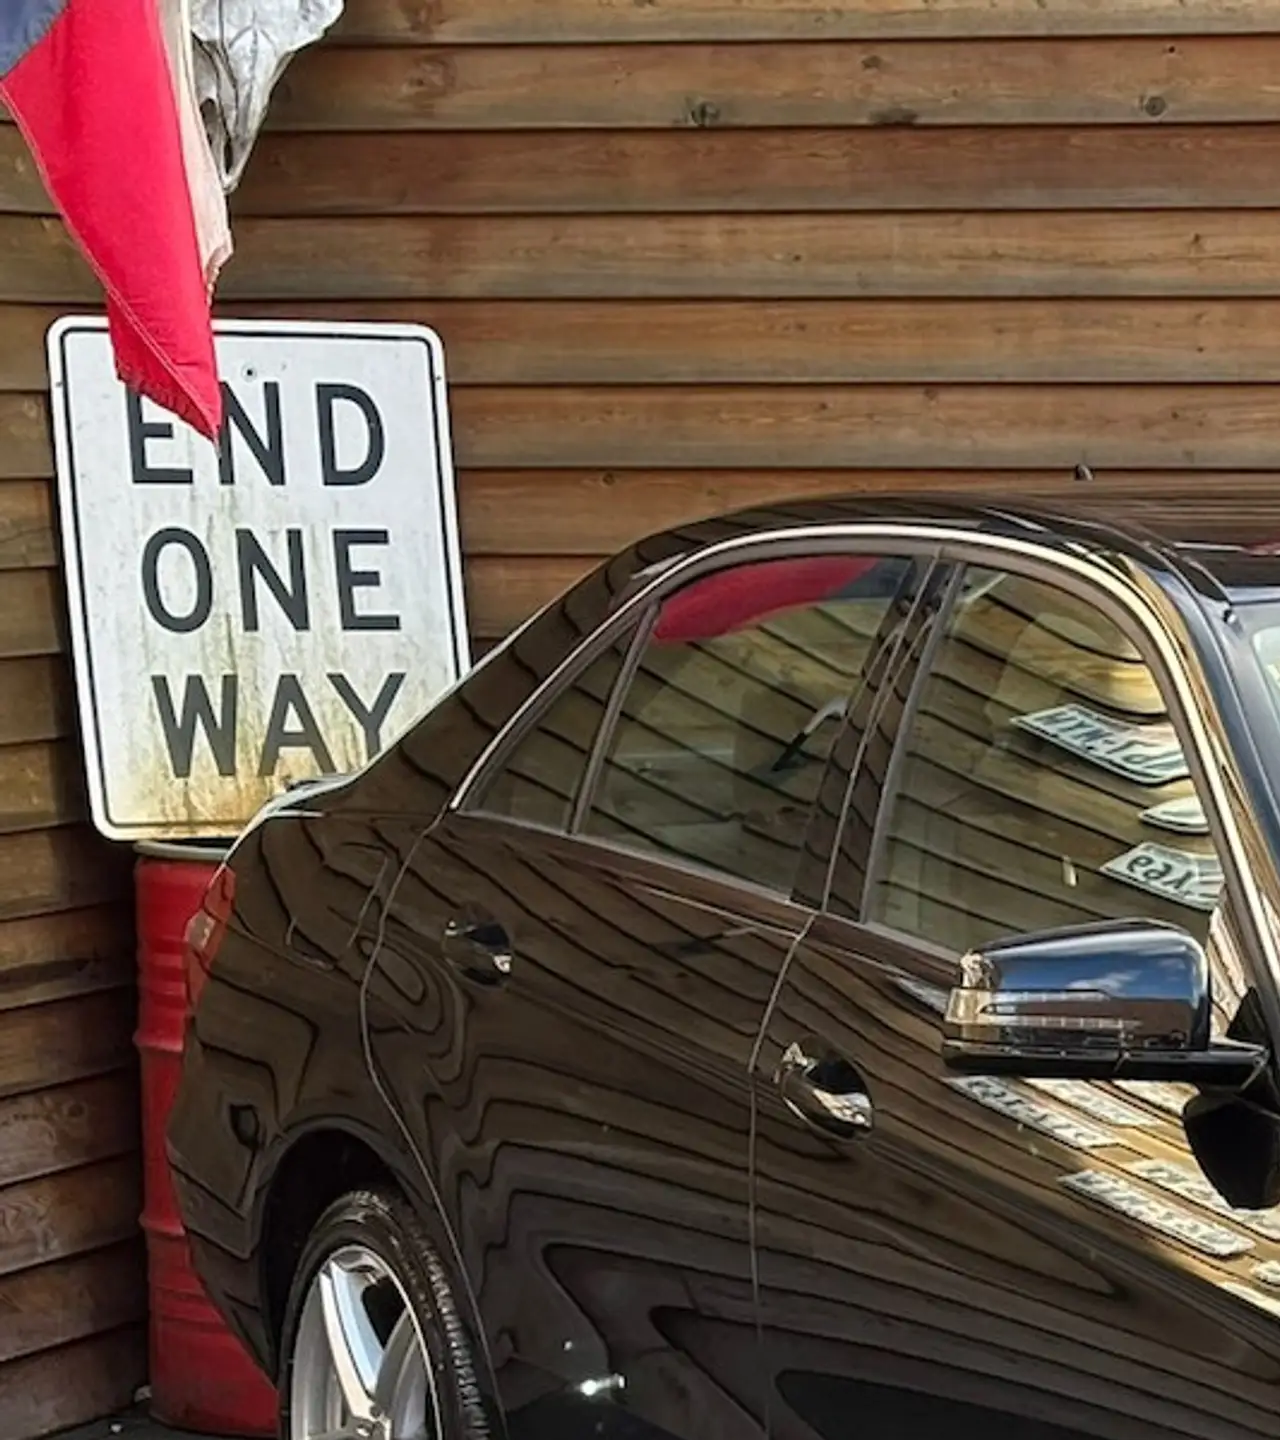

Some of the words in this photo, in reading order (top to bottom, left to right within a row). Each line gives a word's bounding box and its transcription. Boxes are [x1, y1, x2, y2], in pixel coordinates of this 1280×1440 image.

[127, 380, 385, 487] END
[140, 527, 402, 634] ONE
[150, 672, 407, 779] WAY
